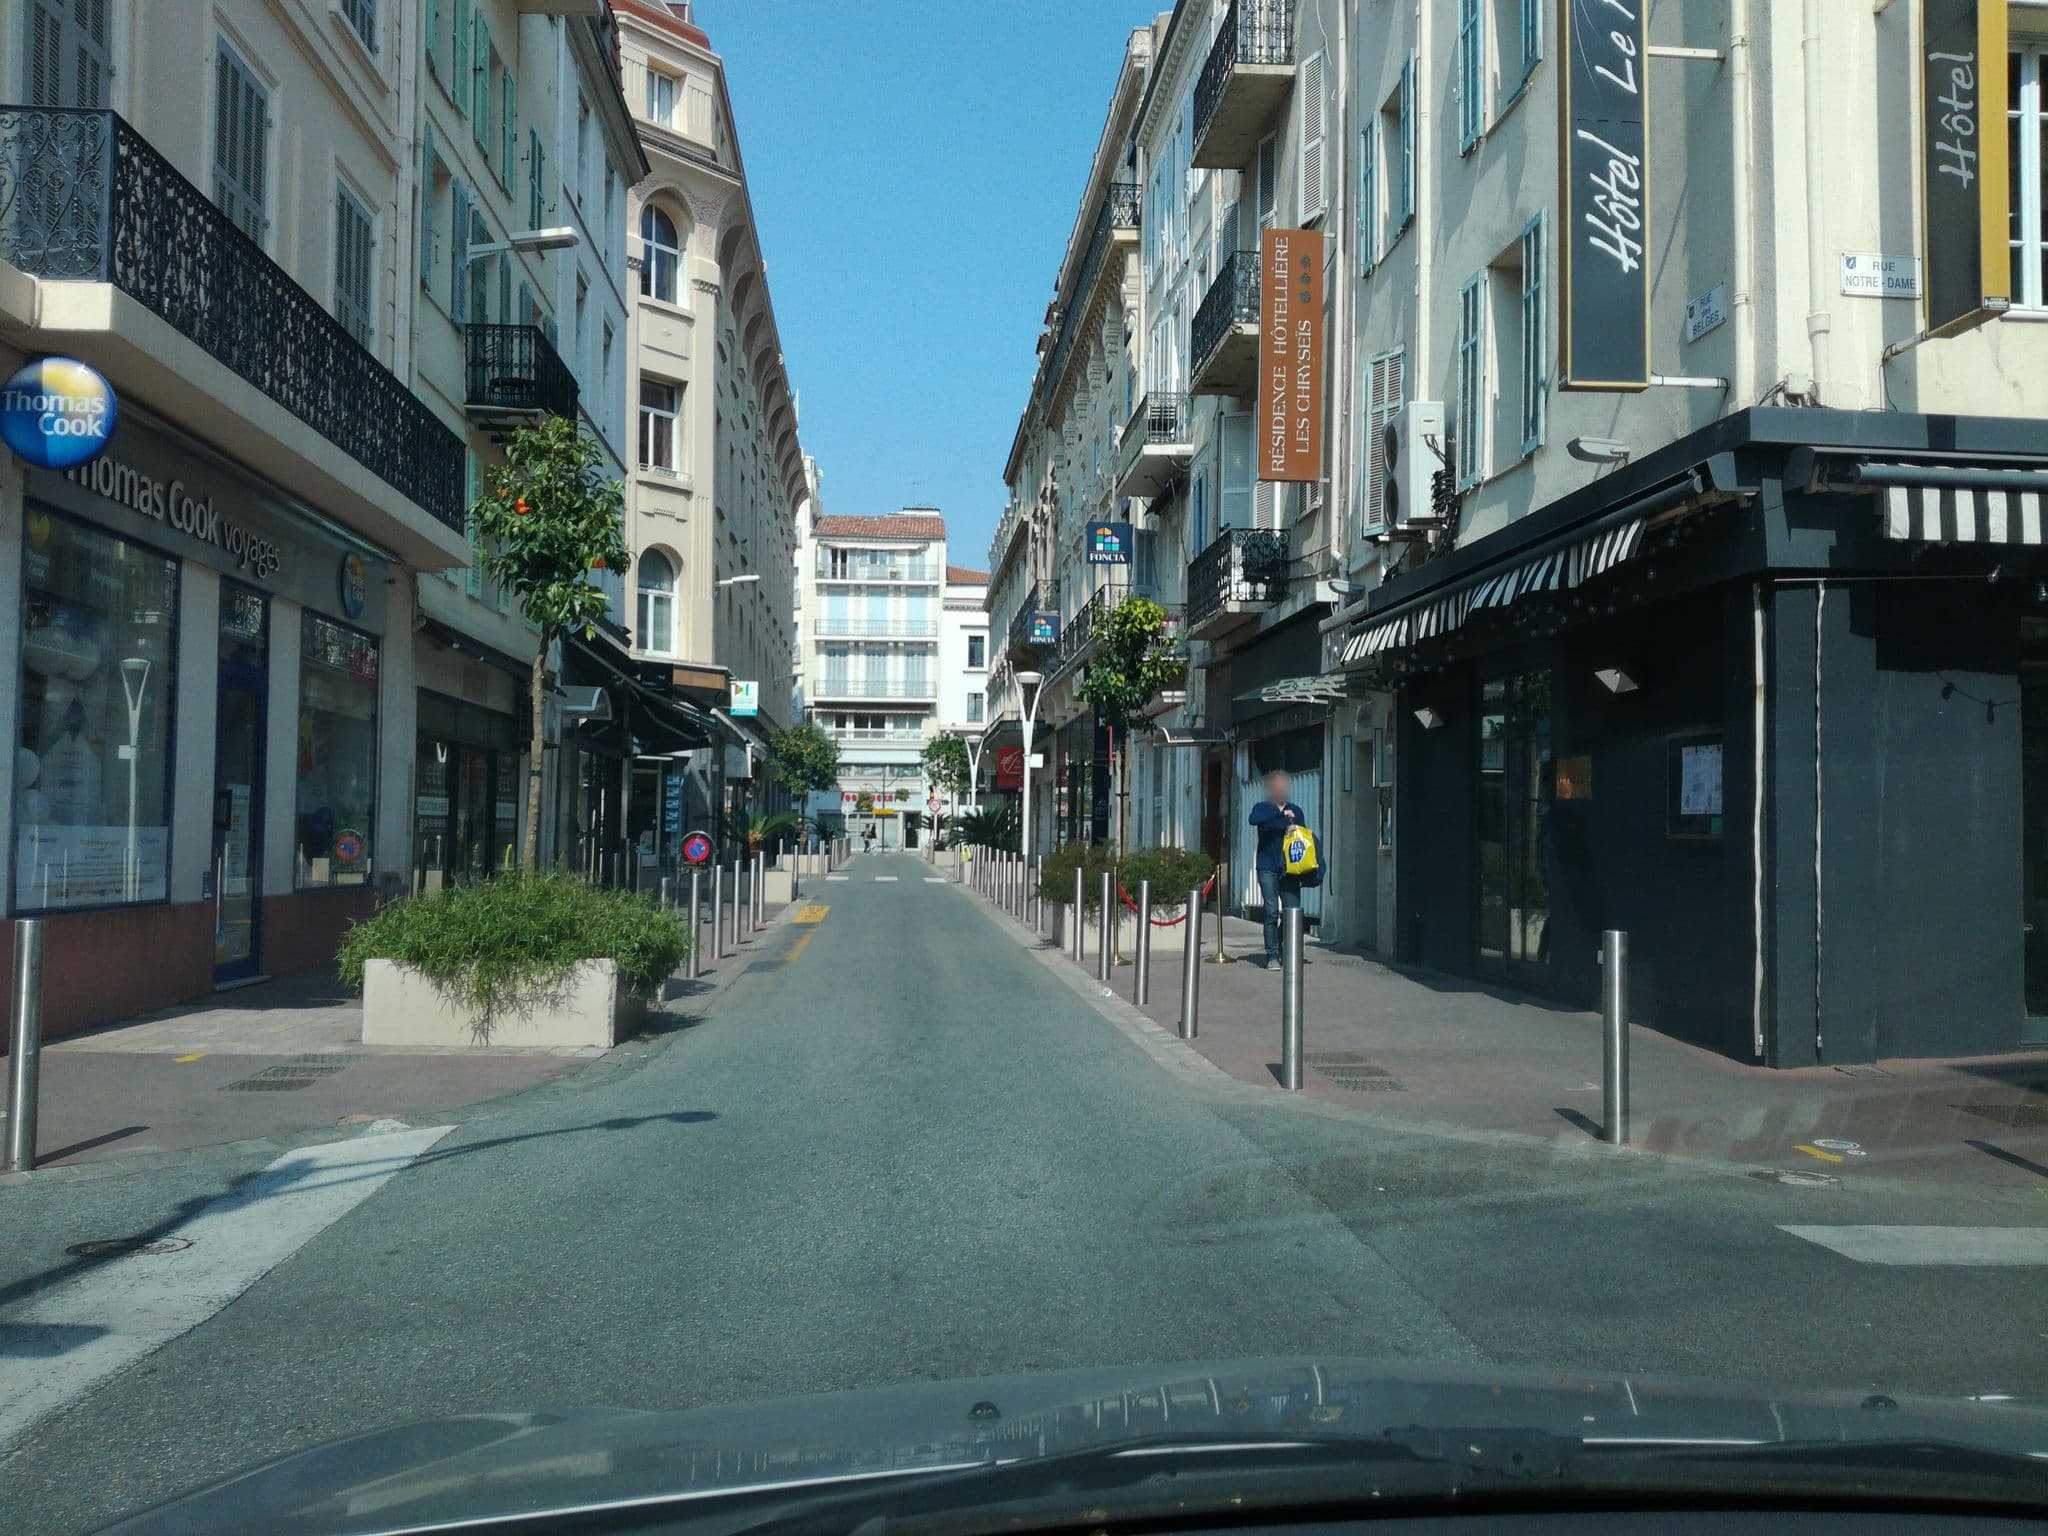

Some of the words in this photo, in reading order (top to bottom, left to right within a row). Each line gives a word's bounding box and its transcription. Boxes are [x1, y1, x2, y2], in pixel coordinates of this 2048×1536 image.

[1594, 30, 1638, 94] Le
[1928, 51, 1976, 189] Hôtel
[1577, 129, 1642, 273] Hôtel
[1872, 260, 1896, 272] RUE
[1270, 236, 1289, 355] HÔTELLIÈRE
[1693, 310, 1719, 337] BELGES
[2, 390, 104, 414] Thomas
[38, 412, 106, 438] Cook
[1268, 366, 1287, 472] RÉSIDENCE
[1295, 417, 1310, 453] LES
[169, 479, 219, 545] Cook
[224, 521, 280, 579] voyages
[1089, 552, 1126, 562] FONCIA
